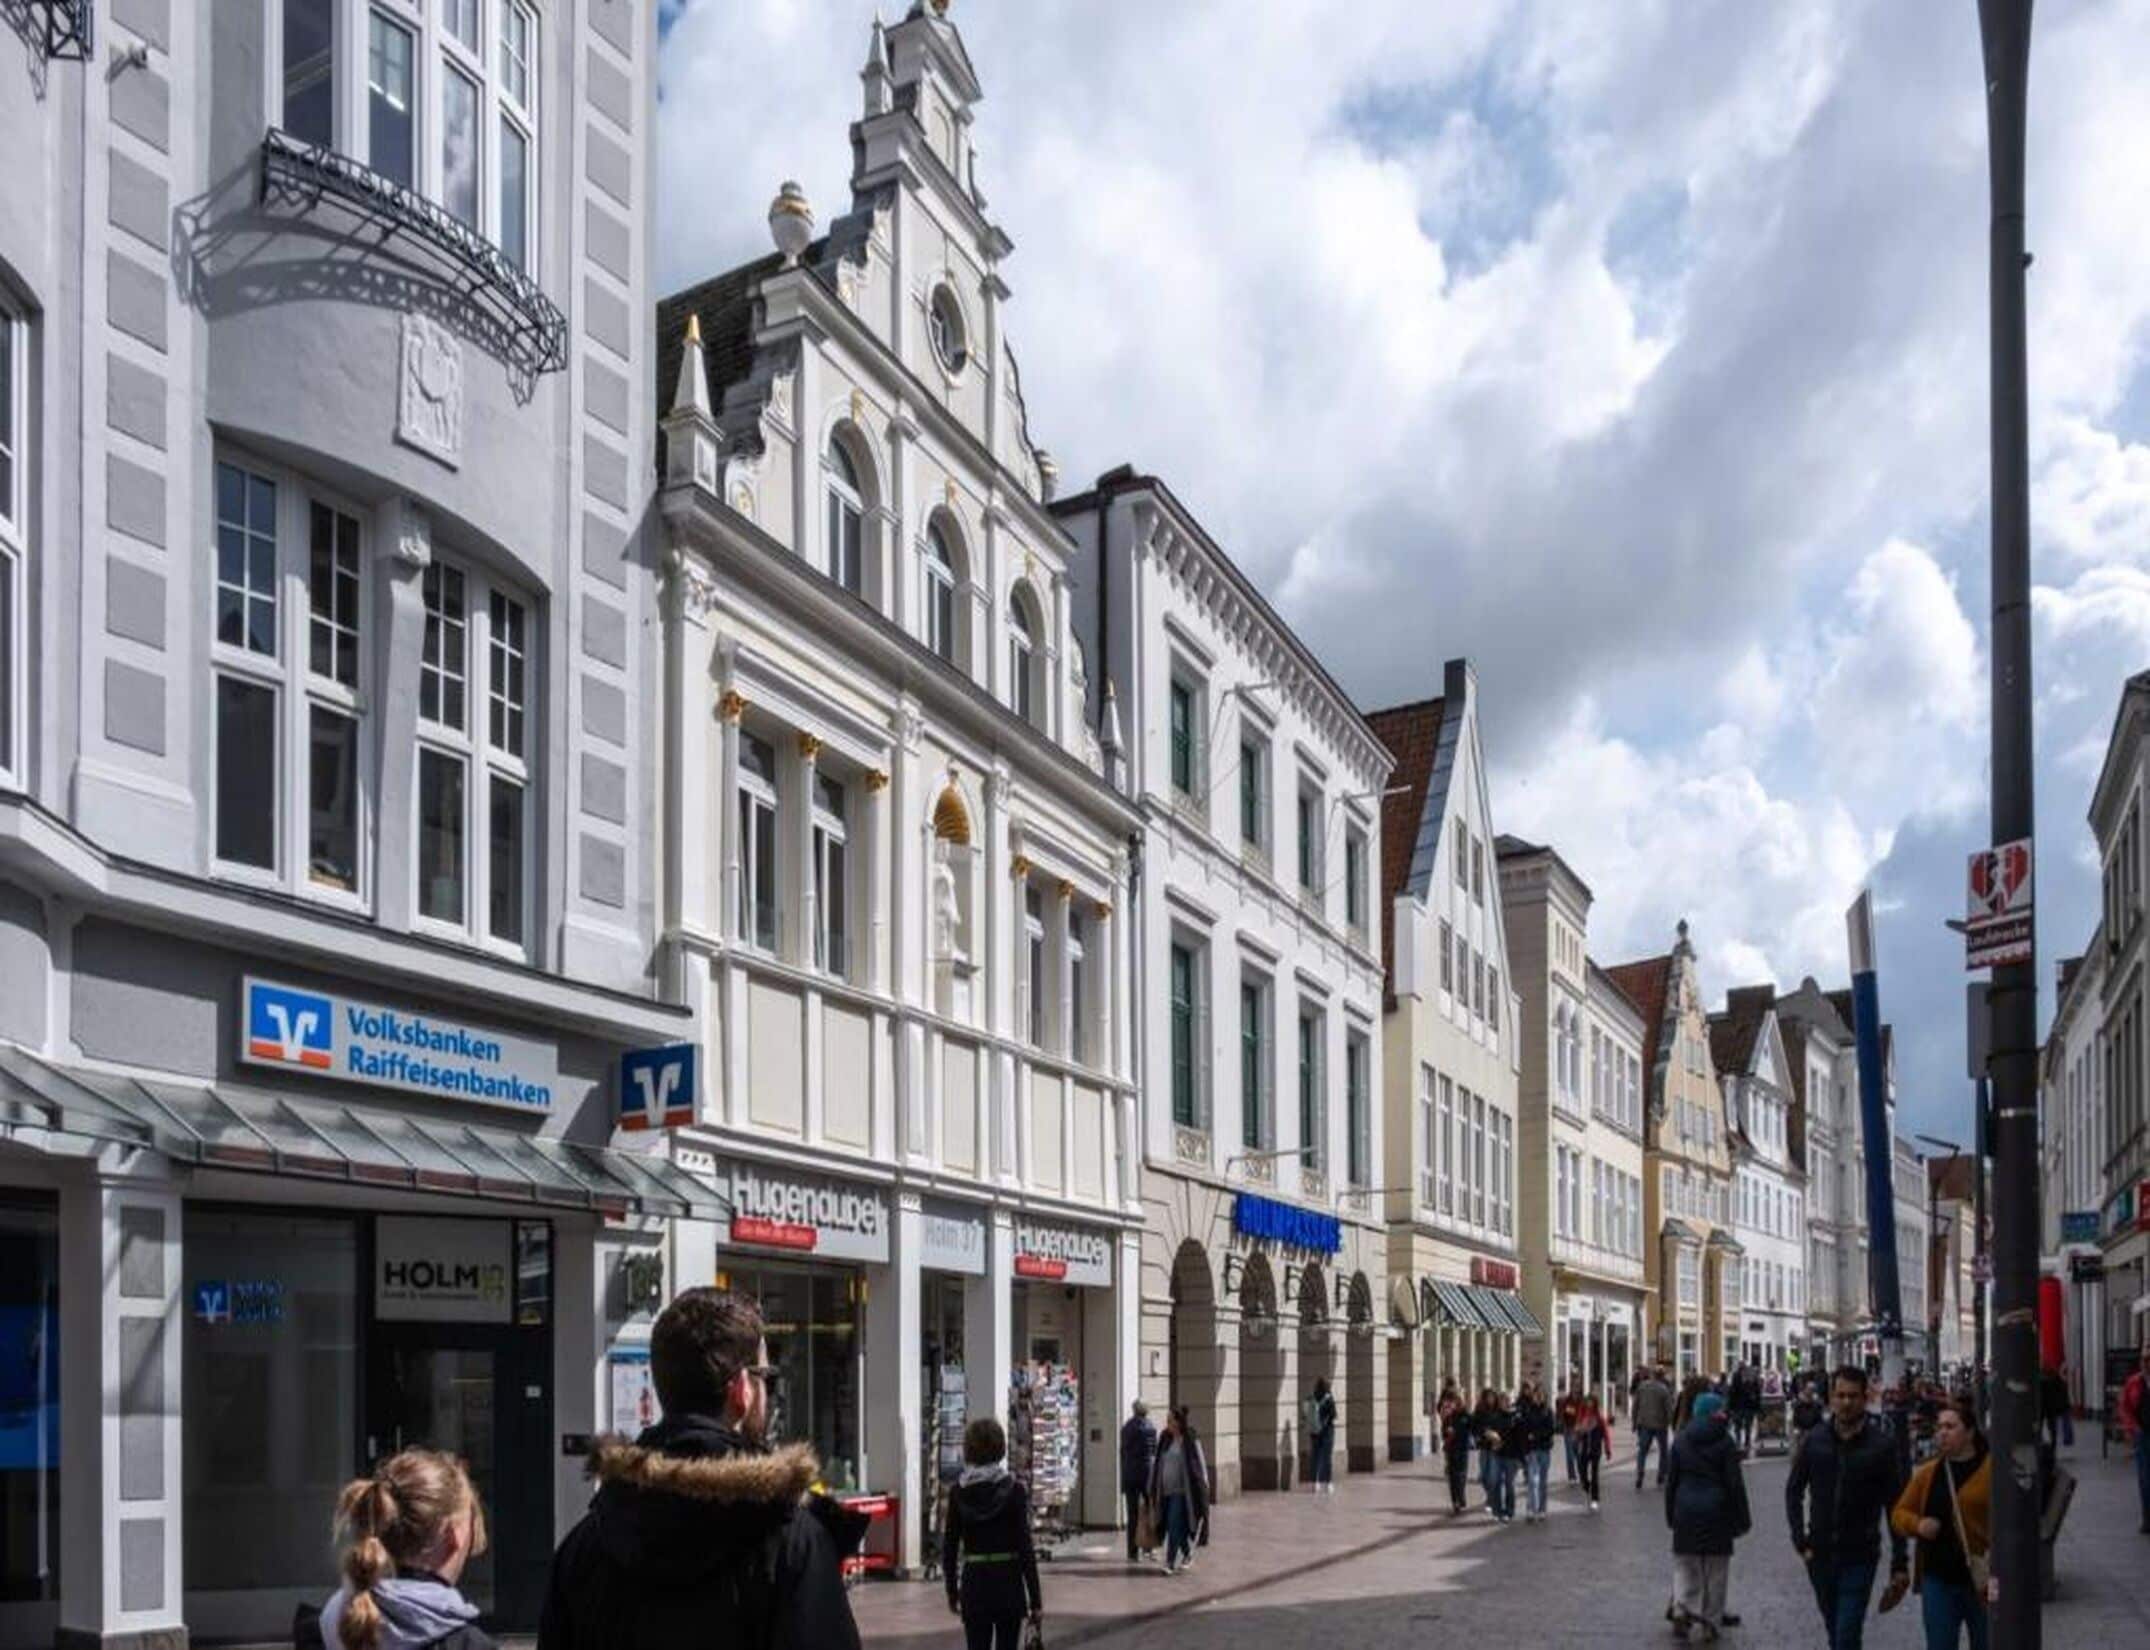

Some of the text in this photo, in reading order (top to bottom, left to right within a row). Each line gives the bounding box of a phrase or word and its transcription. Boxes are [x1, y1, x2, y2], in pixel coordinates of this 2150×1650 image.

[347, 1006, 501, 1062] Volksbanken
[348, 1046, 550, 1105] Raiffeisenbanken
[384, 1261, 478, 1289] HOLM
